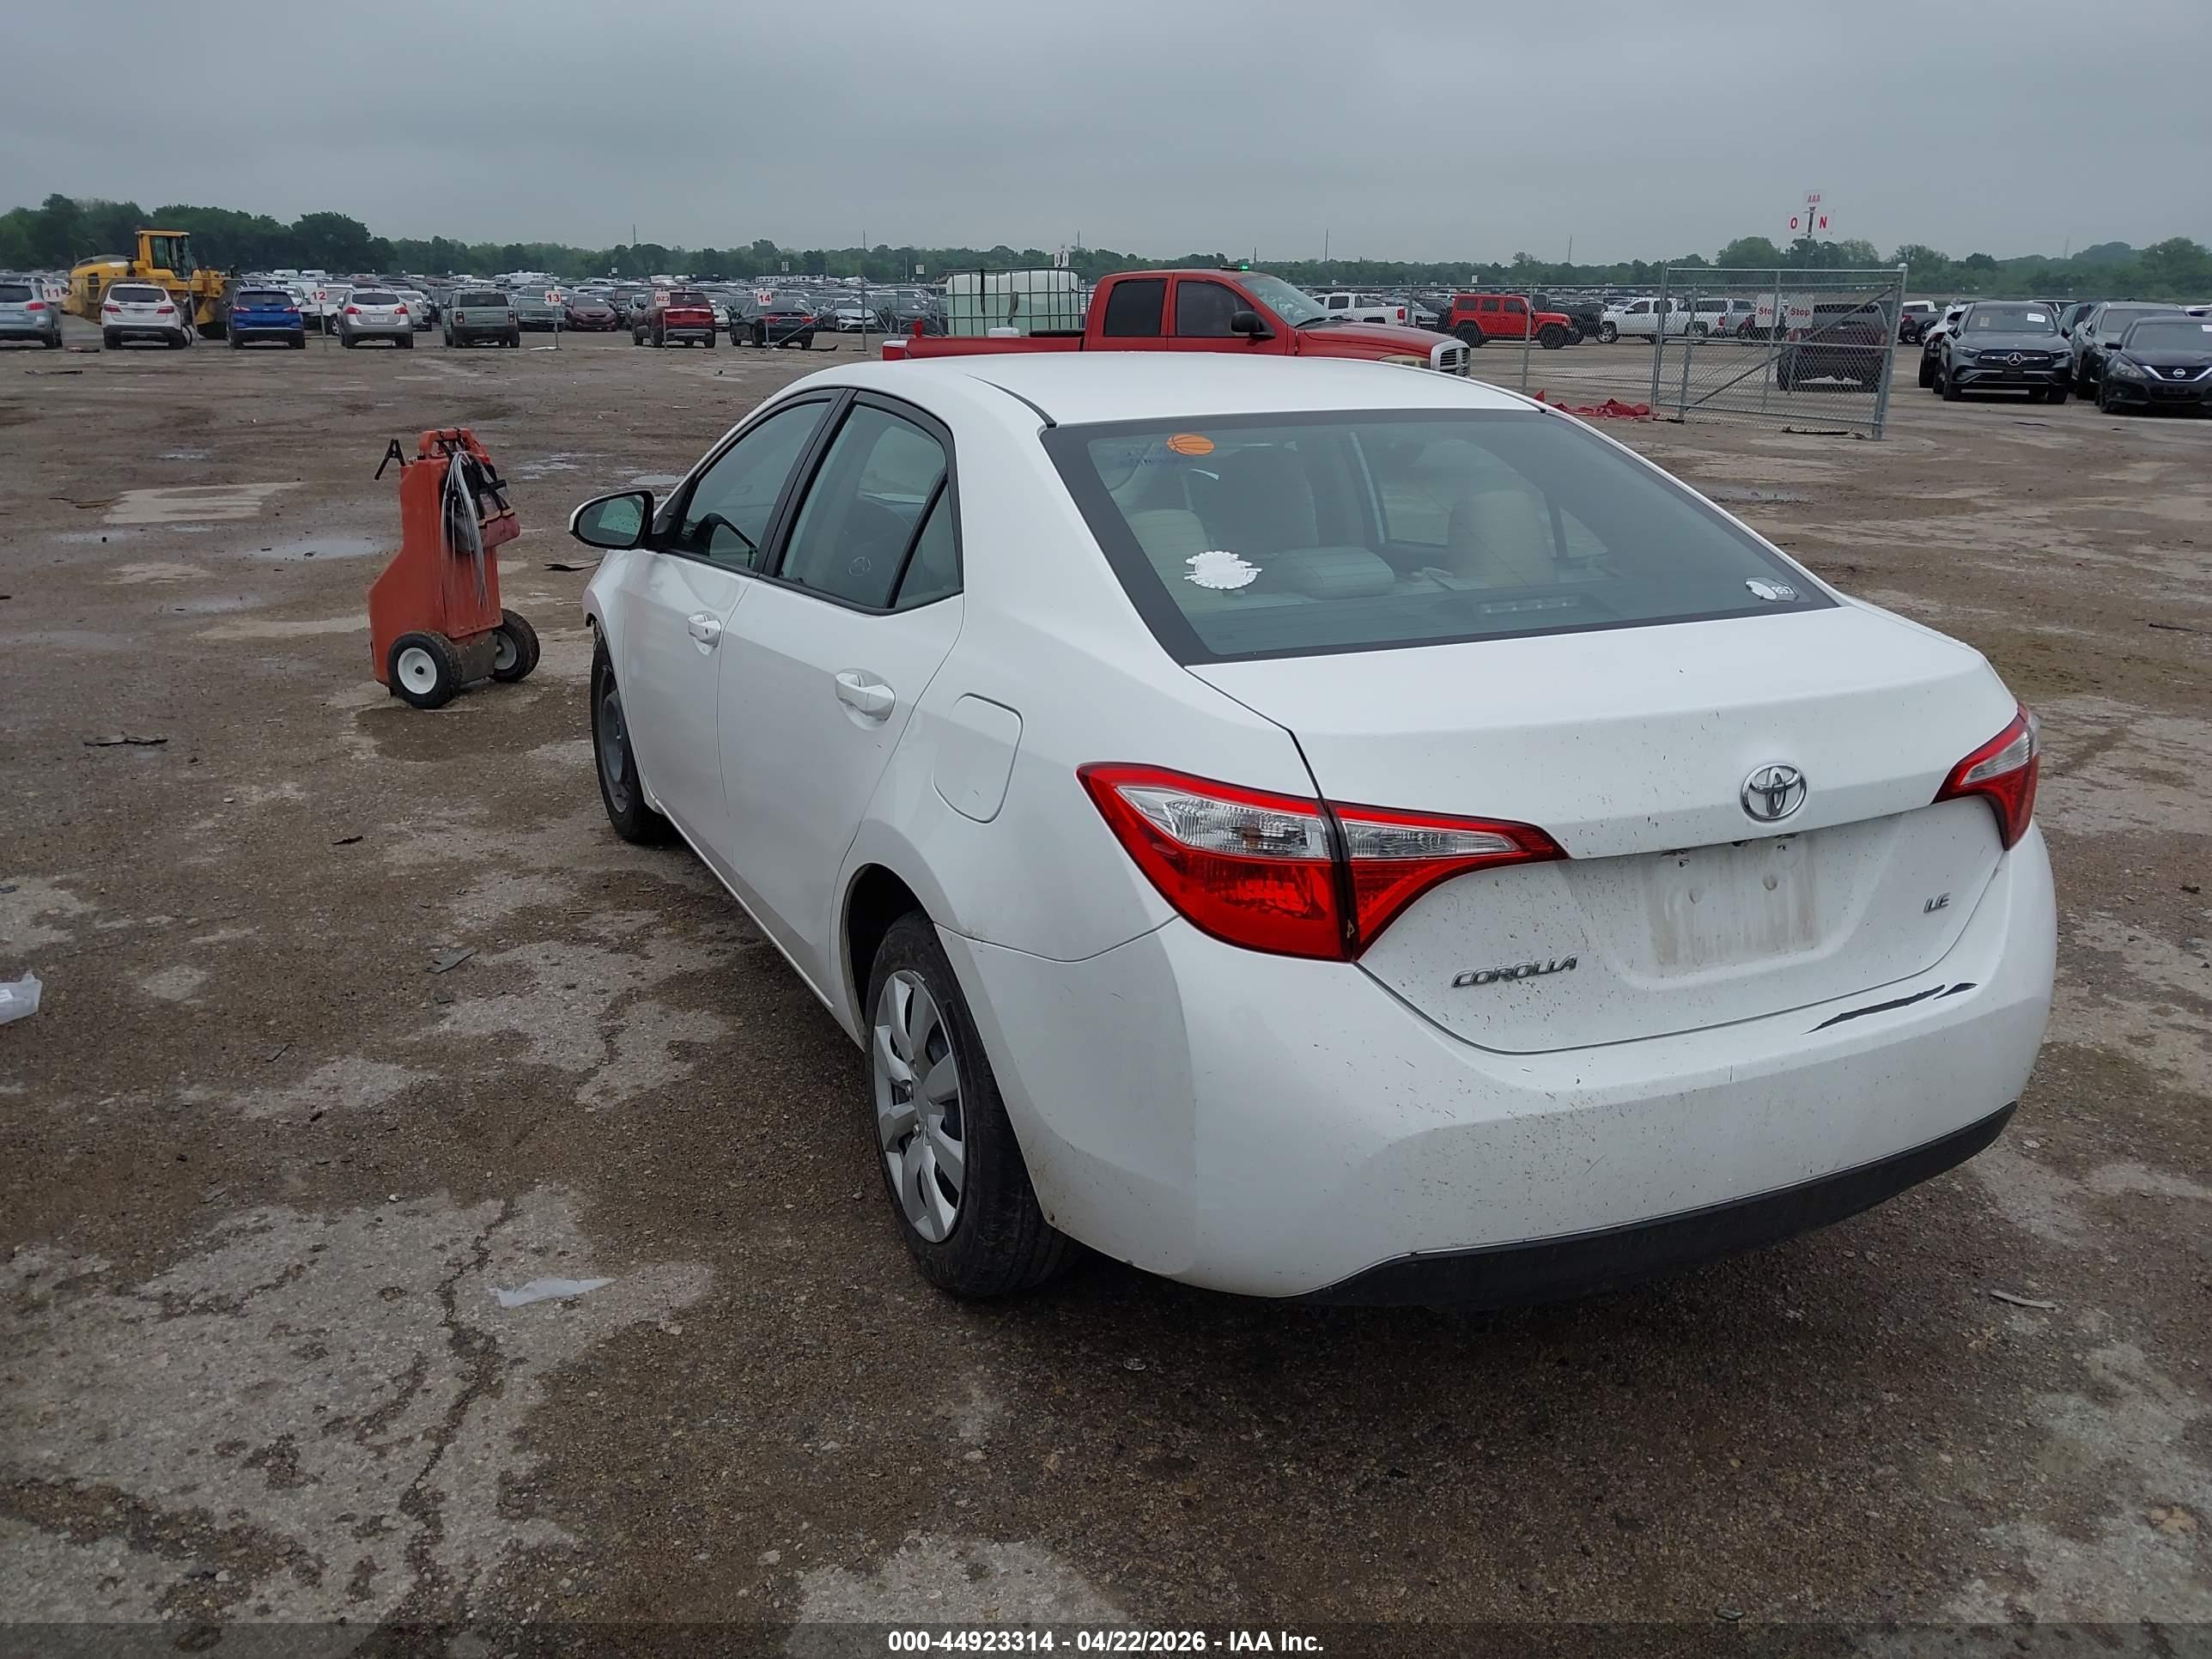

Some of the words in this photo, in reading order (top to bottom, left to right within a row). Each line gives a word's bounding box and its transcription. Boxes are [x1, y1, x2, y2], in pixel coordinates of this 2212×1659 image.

[1807, 194, 1820, 204] AAA
[1819, 216, 1828, 229] N
[45, 288, 59, 297] 11
[311, 291, 326, 301] 12
[546, 294, 560, 302] 13
[759, 294, 770, 302] 14
[1759, 307, 1774, 315] Sto
[1790, 307, 1810, 317] Stop
[1923, 892, 1950, 914] LE
[1451, 954, 1577, 988] COROLLA
